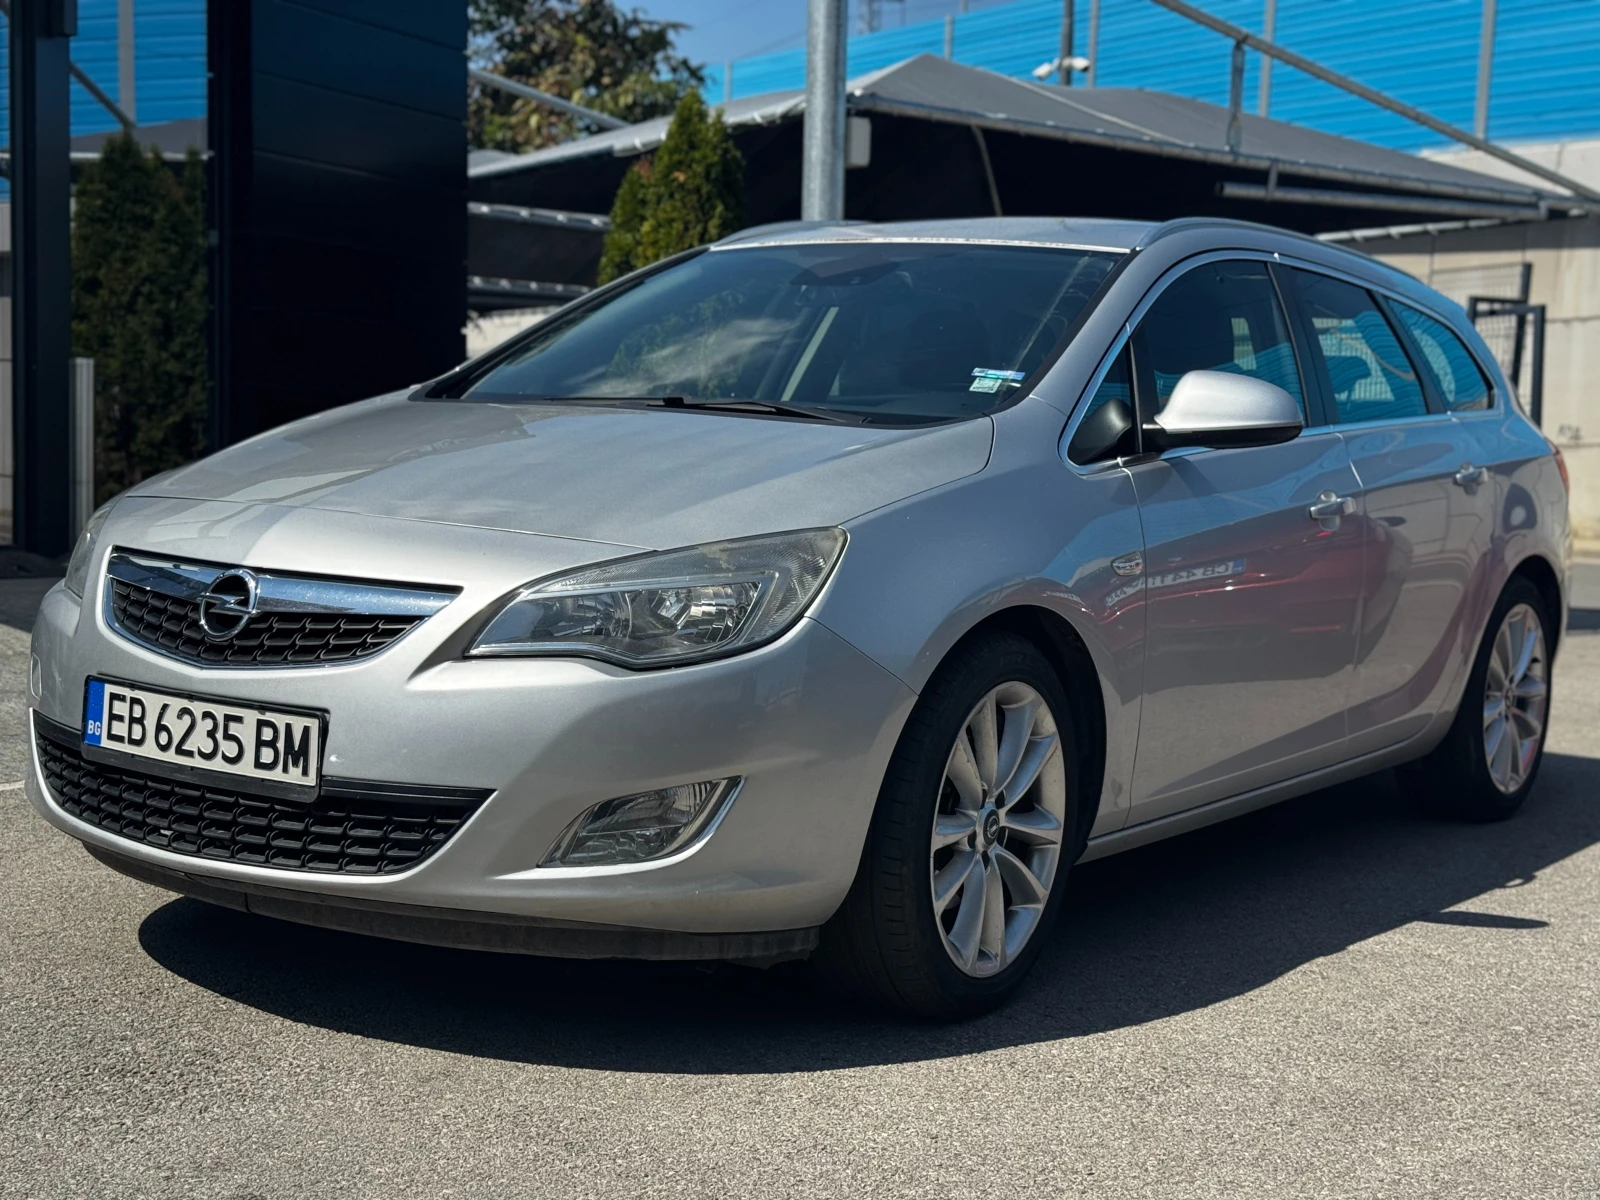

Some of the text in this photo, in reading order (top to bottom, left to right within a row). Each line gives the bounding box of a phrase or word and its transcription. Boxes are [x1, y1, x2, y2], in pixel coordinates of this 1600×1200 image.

[87, 719, 101, 736] BG
[106, 691, 312, 777] EB 6235 BM
